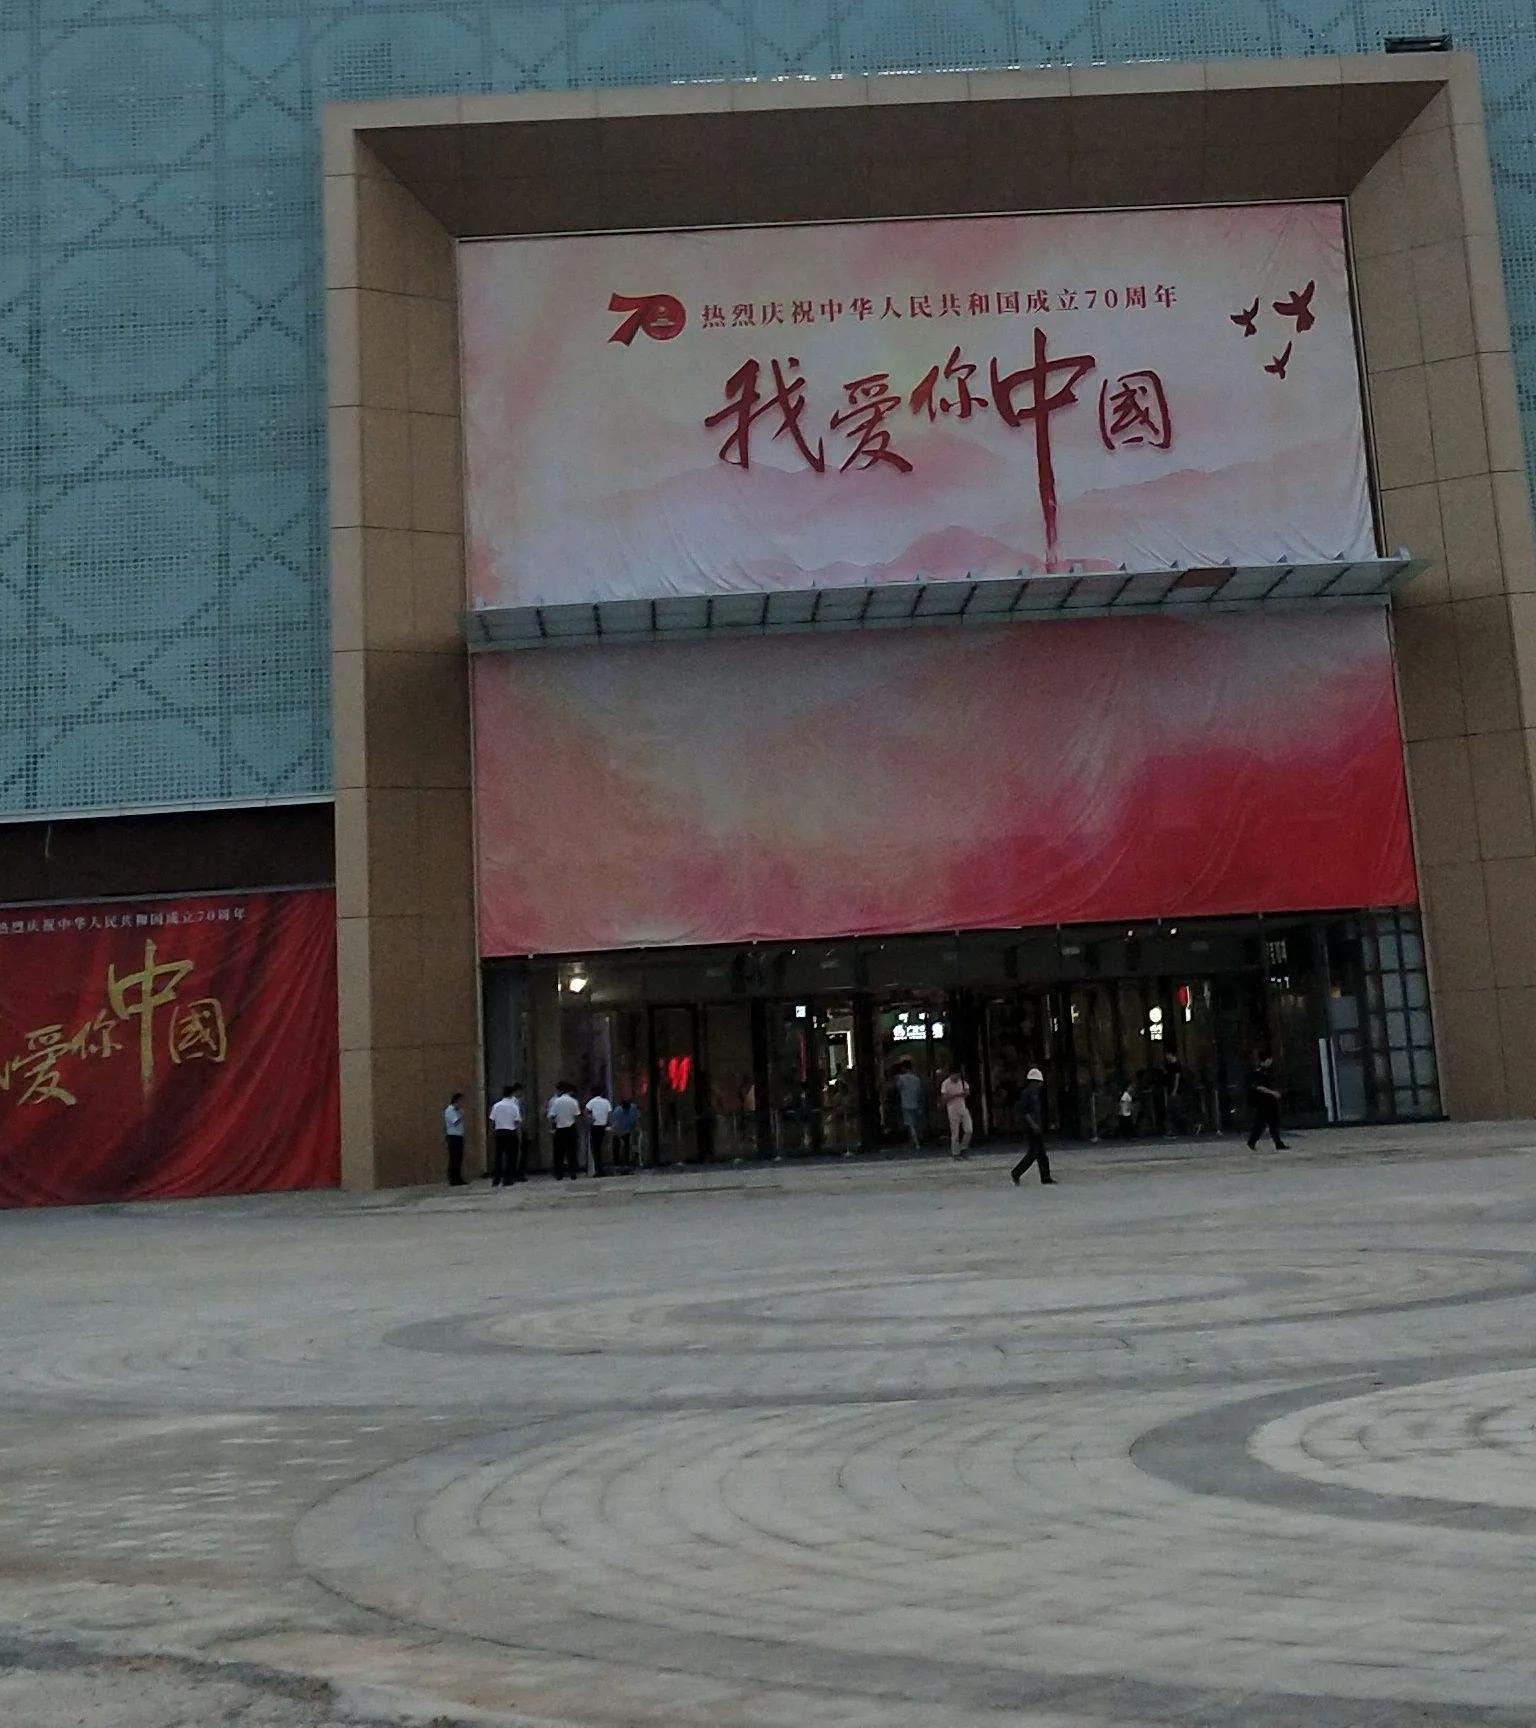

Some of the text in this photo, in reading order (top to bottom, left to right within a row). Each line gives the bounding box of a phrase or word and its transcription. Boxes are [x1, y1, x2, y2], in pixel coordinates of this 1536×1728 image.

[701, 284, 1180, 329] 热烈庆祝中华人民共和国成立70周年
